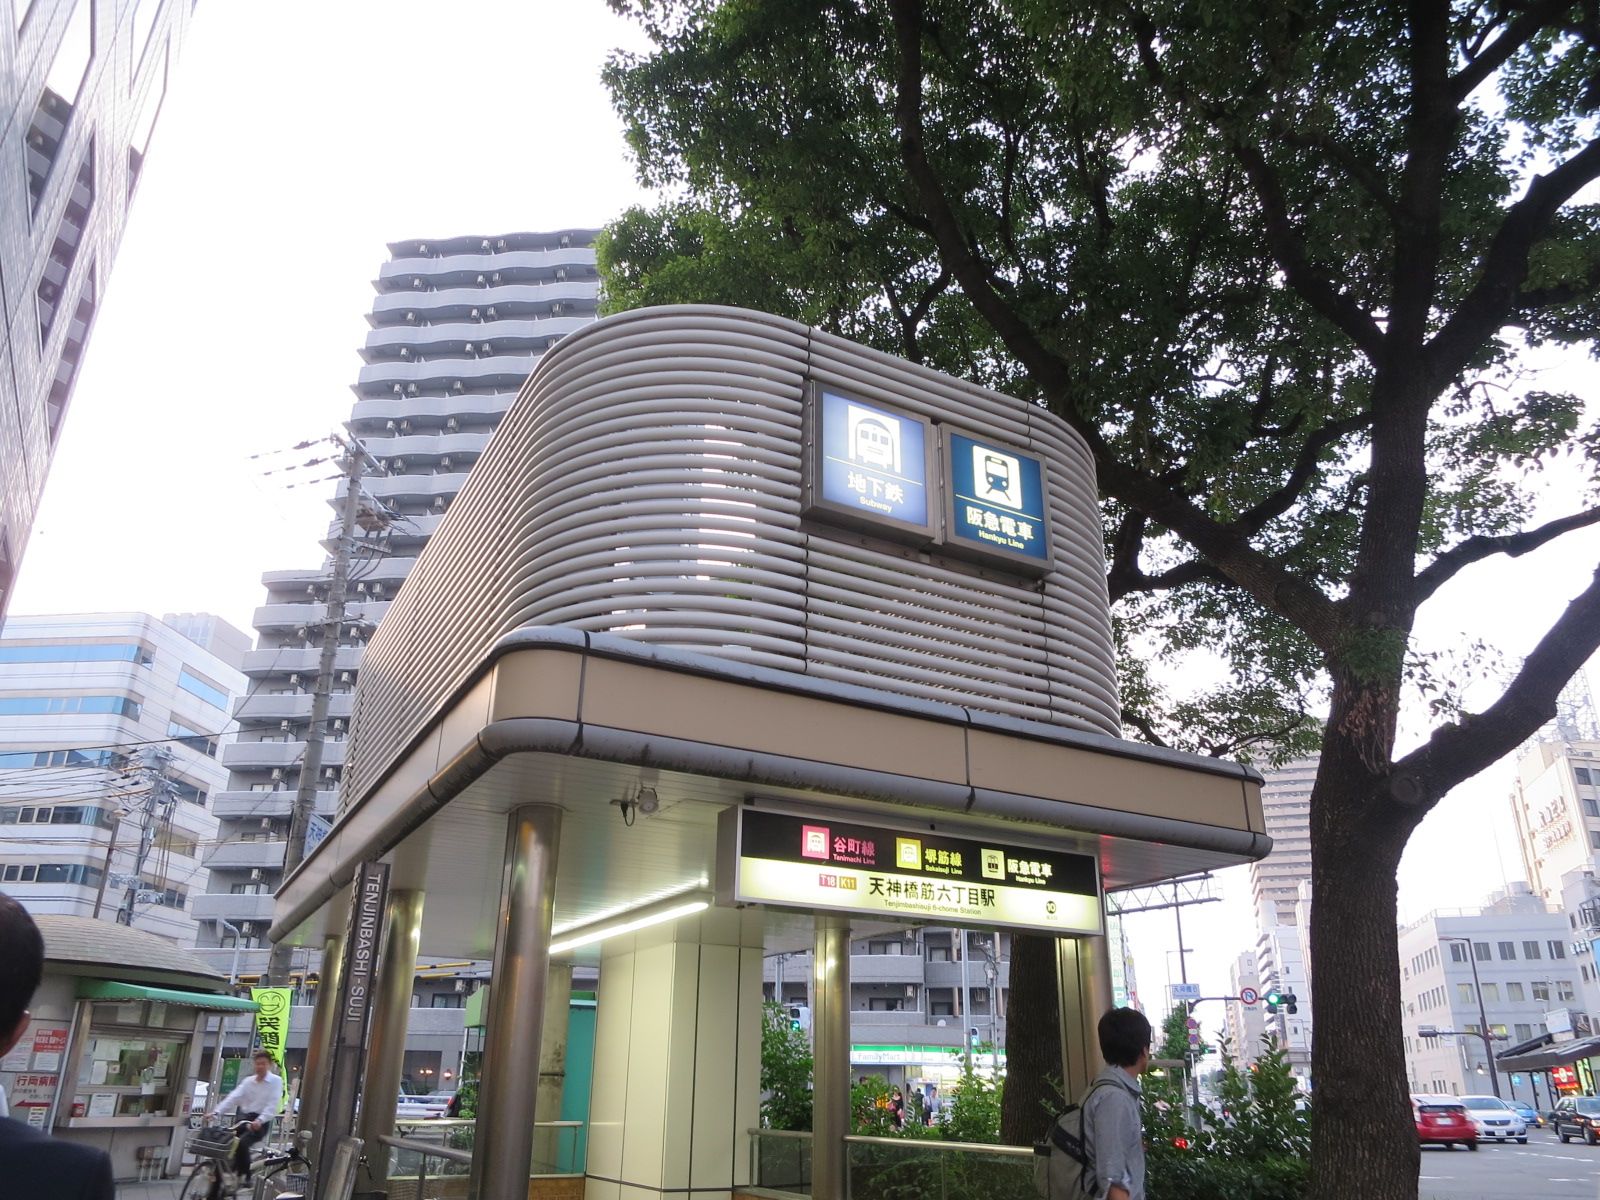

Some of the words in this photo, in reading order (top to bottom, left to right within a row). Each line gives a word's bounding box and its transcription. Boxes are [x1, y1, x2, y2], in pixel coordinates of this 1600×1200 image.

[848, 471, 904, 504] 地下鉄
[859, 496, 892, 513] Subway
[966, 506, 1034, 541] 阪急電車
[978, 529, 1007, 545] Hankyu
[1007, 536, 1025, 550] Line
[833, 836, 876, 857] 谷町線
[833, 853, 862, 864] Tanimachi
[862, 856, 876, 865] Line
[924, 848, 963, 867] 堺筋線
[950, 866, 963, 875] Line
[1006, 858, 1053, 878] 阪急電車
[820, 875, 836, 887] T18
[840, 876, 856, 889] K11
[1015, 874, 1035, 884] Hankyu
[1035, 877, 1047, 885] Line
[869, 876, 995, 907] 天神橋筋六丁目駅
[959, 907, 982, 916] Station
